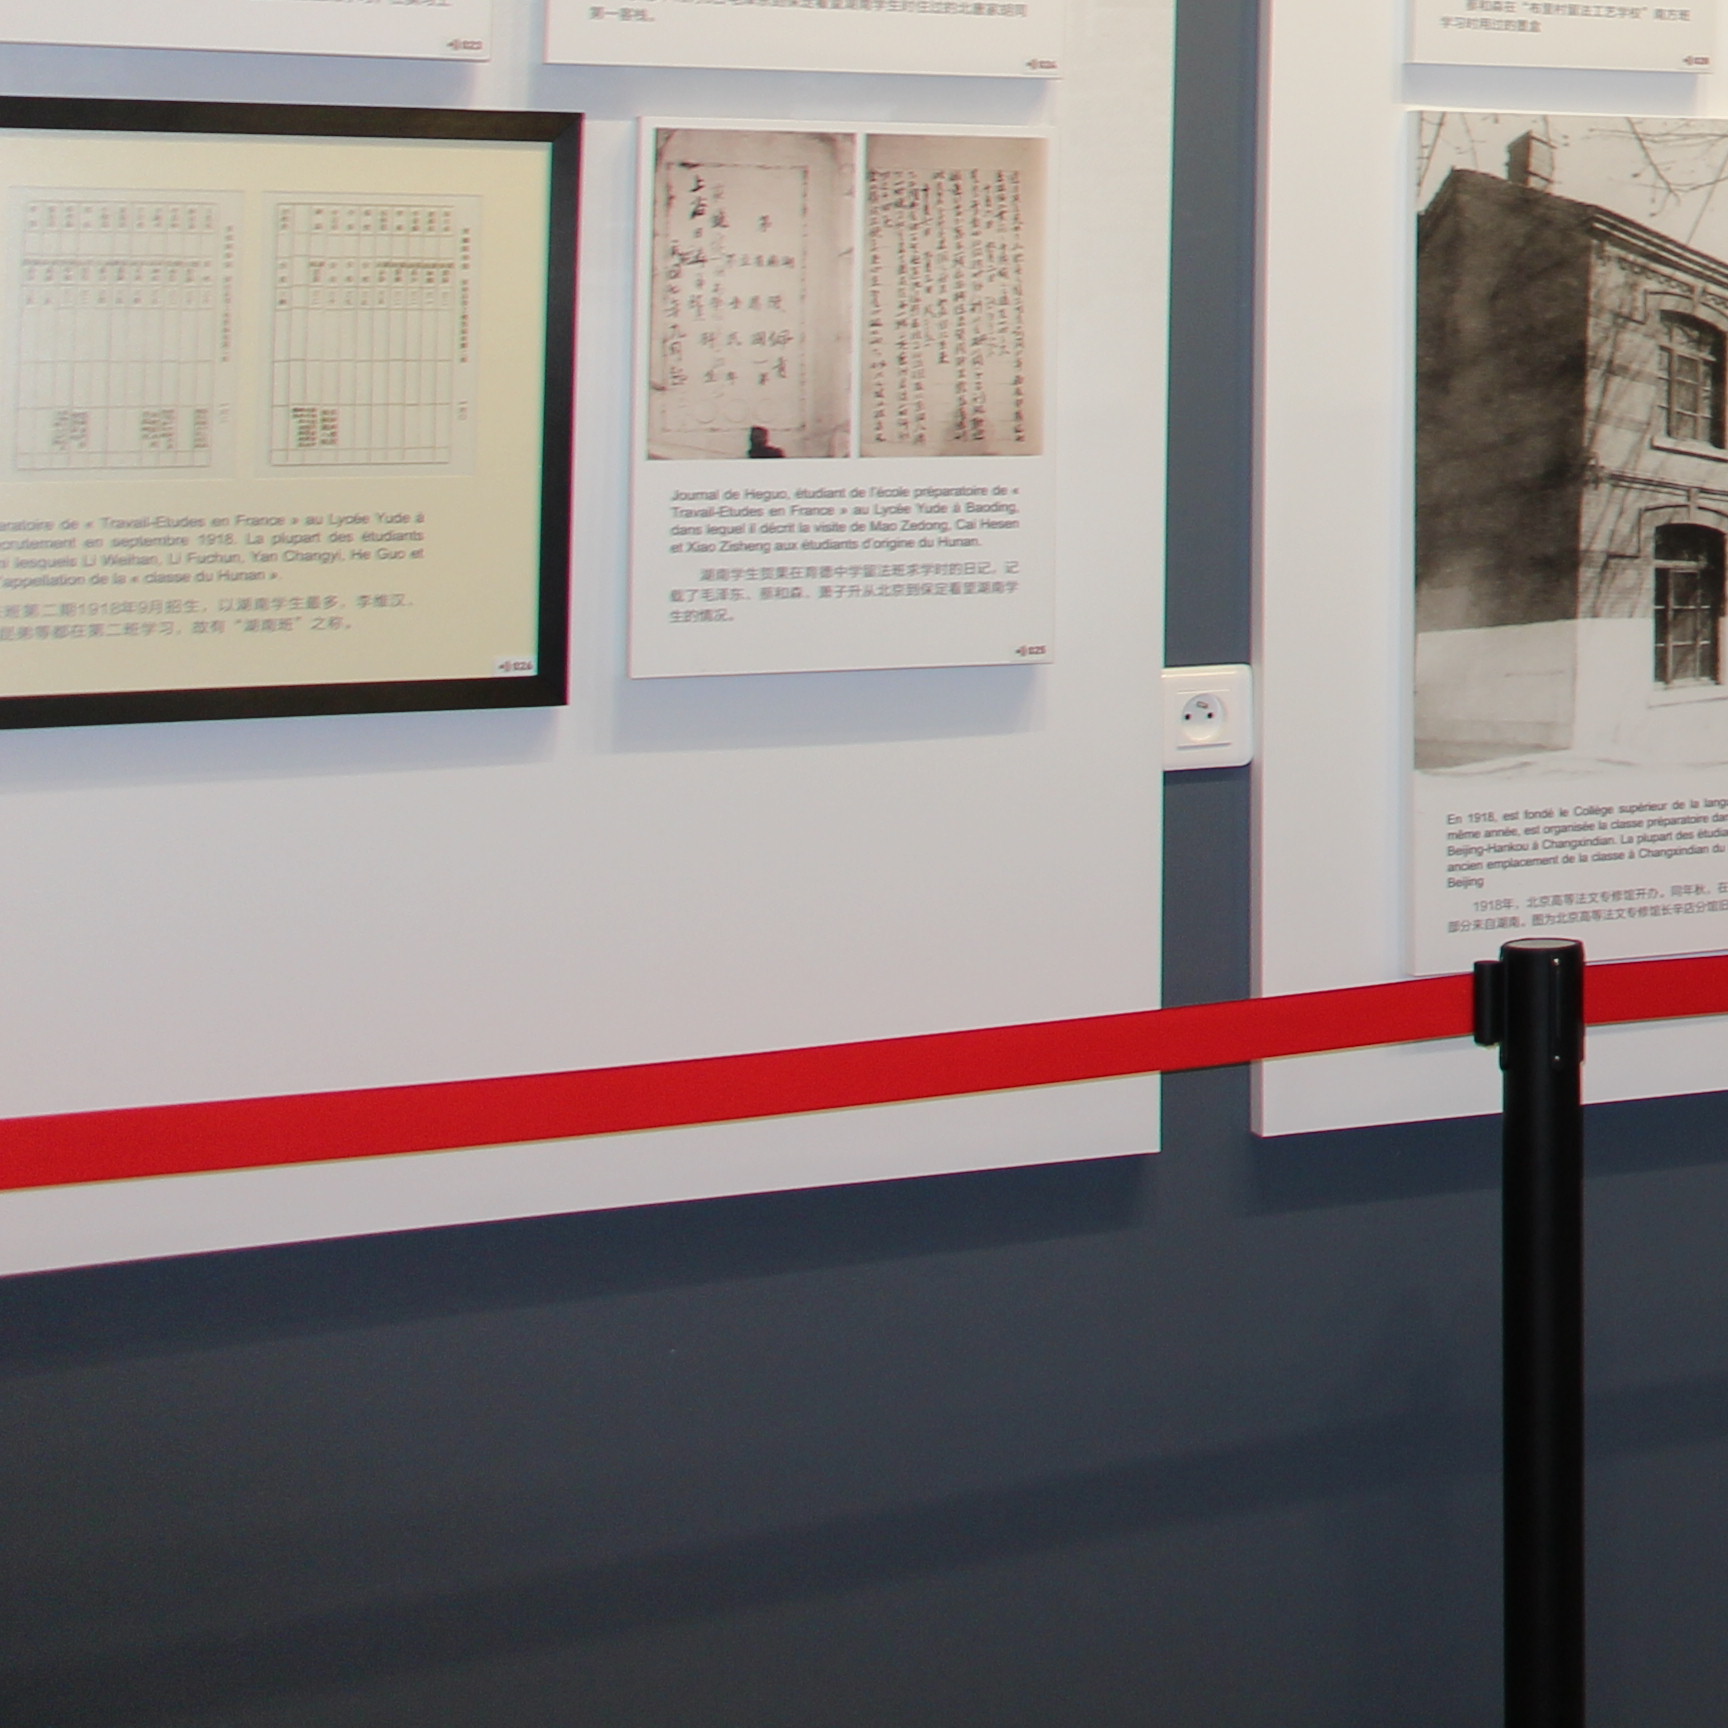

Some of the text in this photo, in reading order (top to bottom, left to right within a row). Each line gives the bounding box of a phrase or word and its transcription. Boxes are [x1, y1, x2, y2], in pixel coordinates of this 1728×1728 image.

[1447, 814, 1463, 824] En
[1502, 810, 1520, 822] est
[1523, 808, 1555, 820] fondé
[1559, 806, 1570, 818] le
[1573, 804, 1615, 818] Collège
[1618, 800, 1668, 816] supérieur
[1672, 798, 1686, 810] de
[1689, 798, 1701, 808] la
[1447, 840, 1530, 858] Beijing-Hankou
[1532, 838, 1540, 850] à
[1620, 832, 1635, 844] La
[1637, 830, 1674, 846] plupart
[1675, 828, 1695, 840] des
[1447, 876, 1485, 890] Beijing
